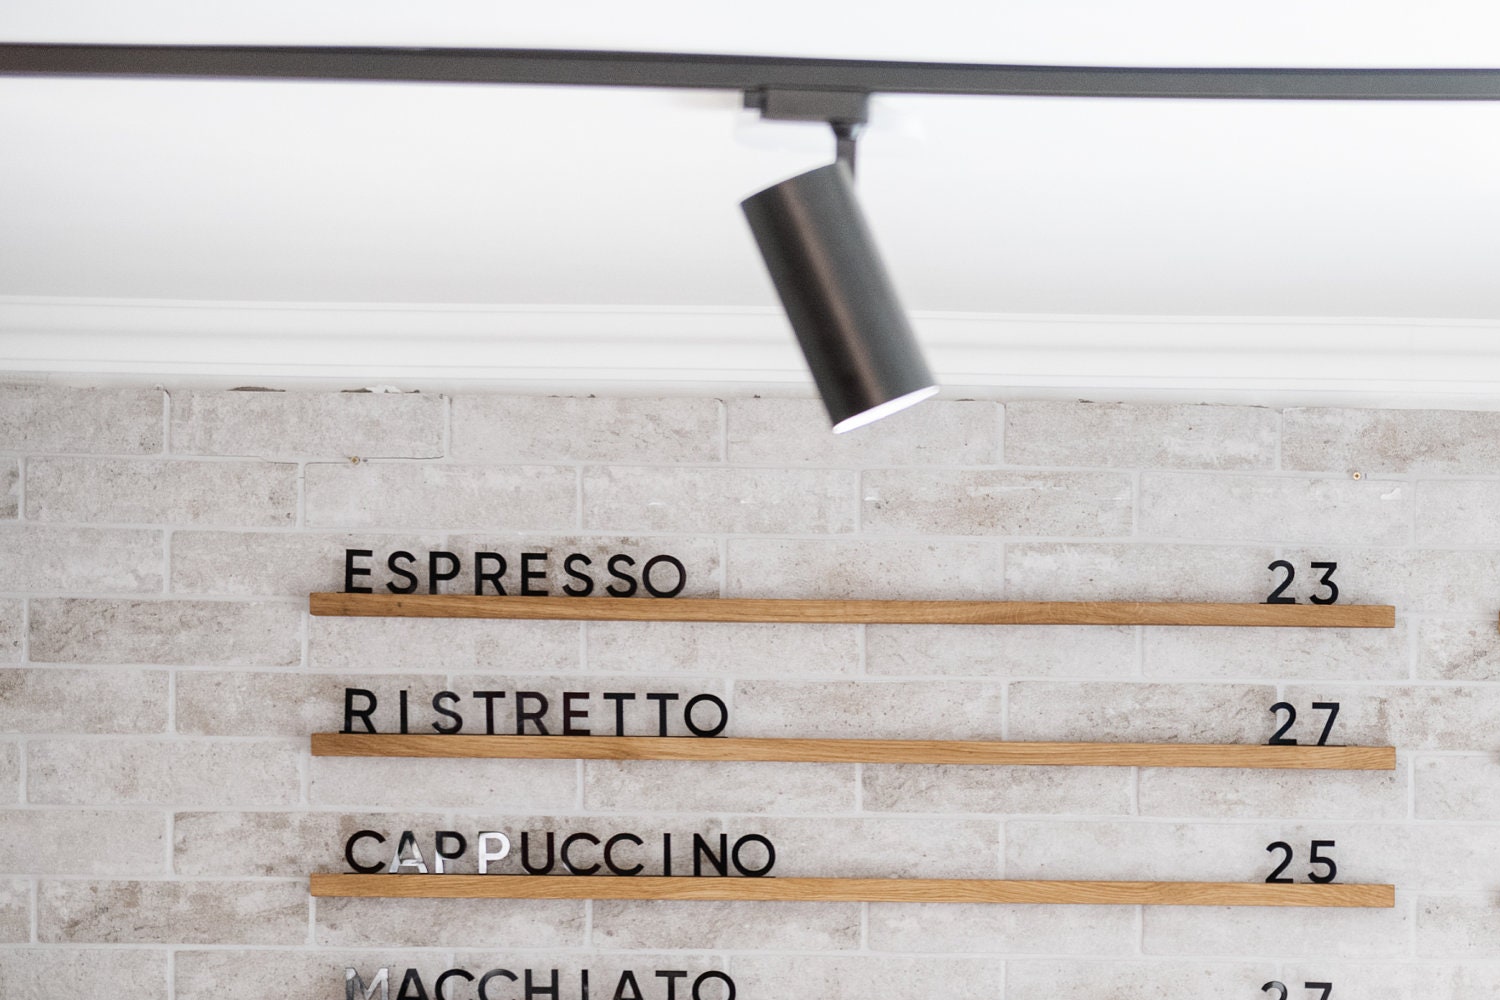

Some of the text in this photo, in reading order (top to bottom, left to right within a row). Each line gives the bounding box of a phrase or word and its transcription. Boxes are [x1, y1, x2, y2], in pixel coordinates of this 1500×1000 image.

[345, 549, 1339, 605] ESPRESSO 23
[345, 688, 1341, 746] RISTRETTO 27
[345, 829, 1337, 884] CAPPUCCINO 25
